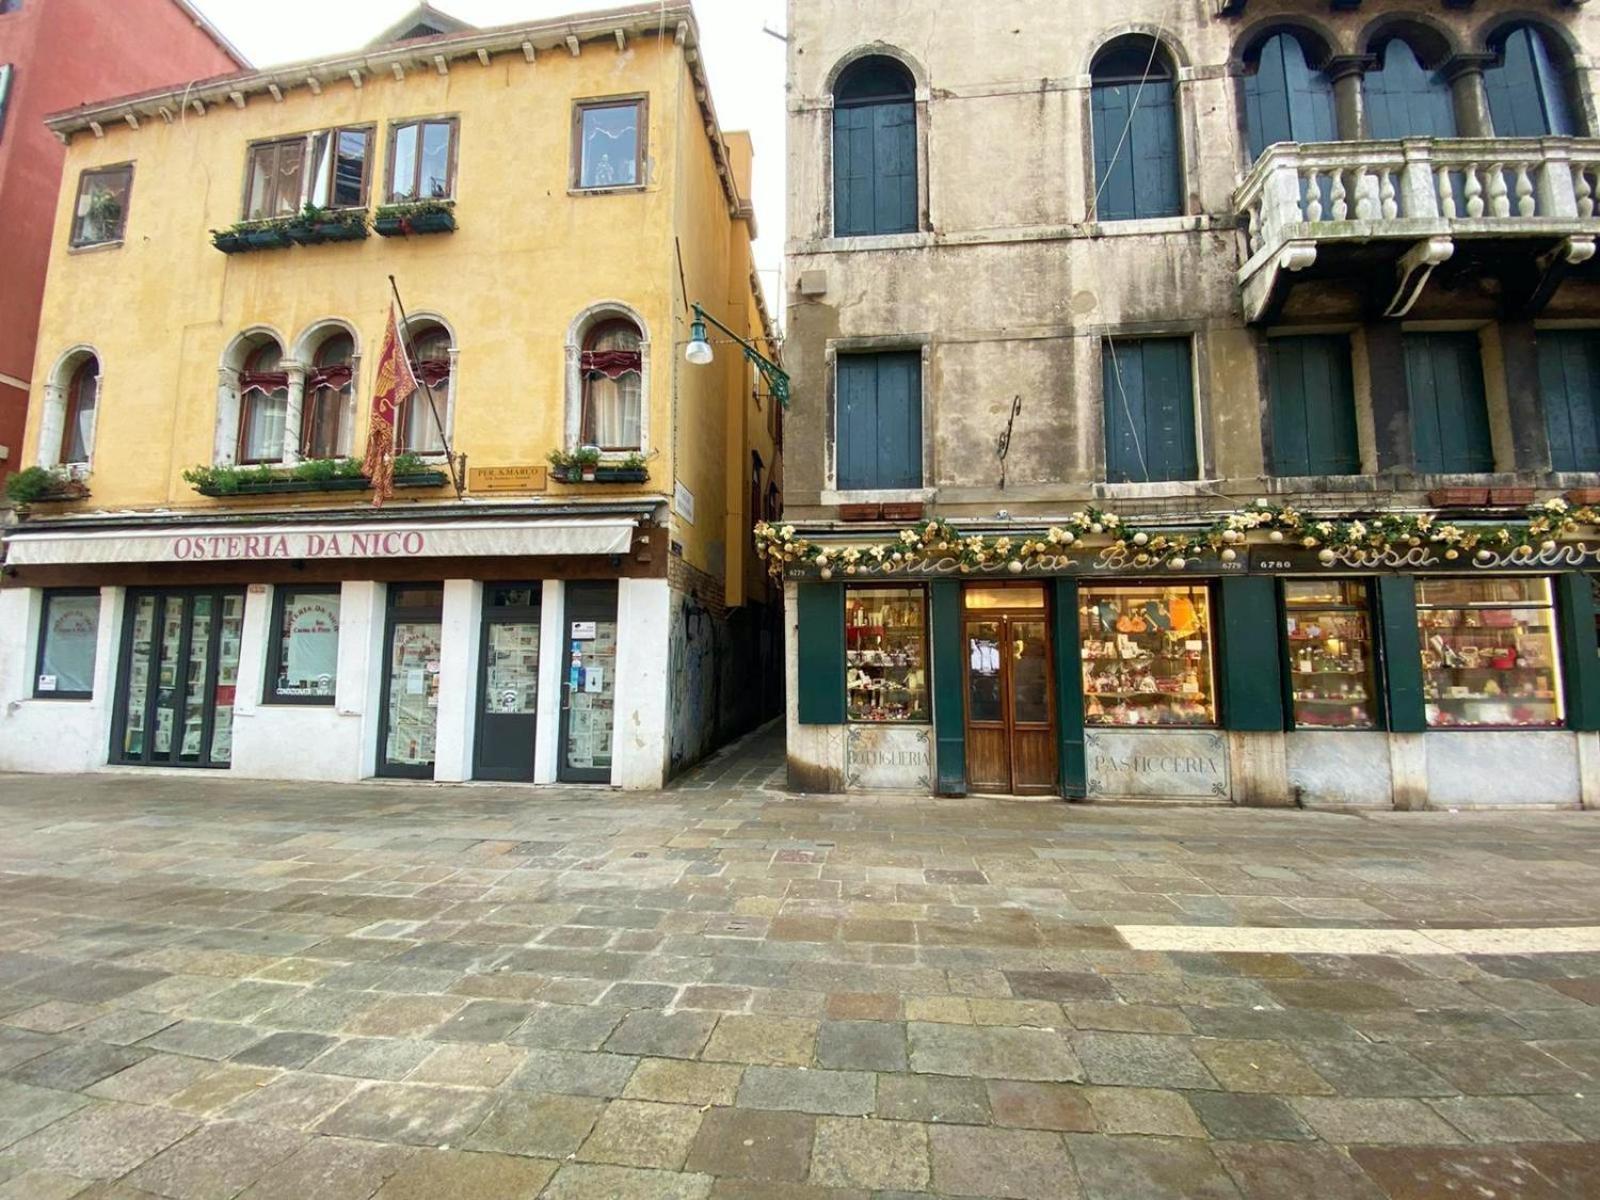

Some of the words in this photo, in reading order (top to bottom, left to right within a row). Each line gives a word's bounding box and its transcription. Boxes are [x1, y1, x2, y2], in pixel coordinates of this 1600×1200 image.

[174, 535, 290, 560] OSTERIA
[305, 533, 342, 557] DA
[350, 531, 425, 556] NICO
[1472, 540, 1600, 570] Salv
[1260, 561, 1291, 569] 6780
[1095, 755, 1218, 774] PASTICCERIA
